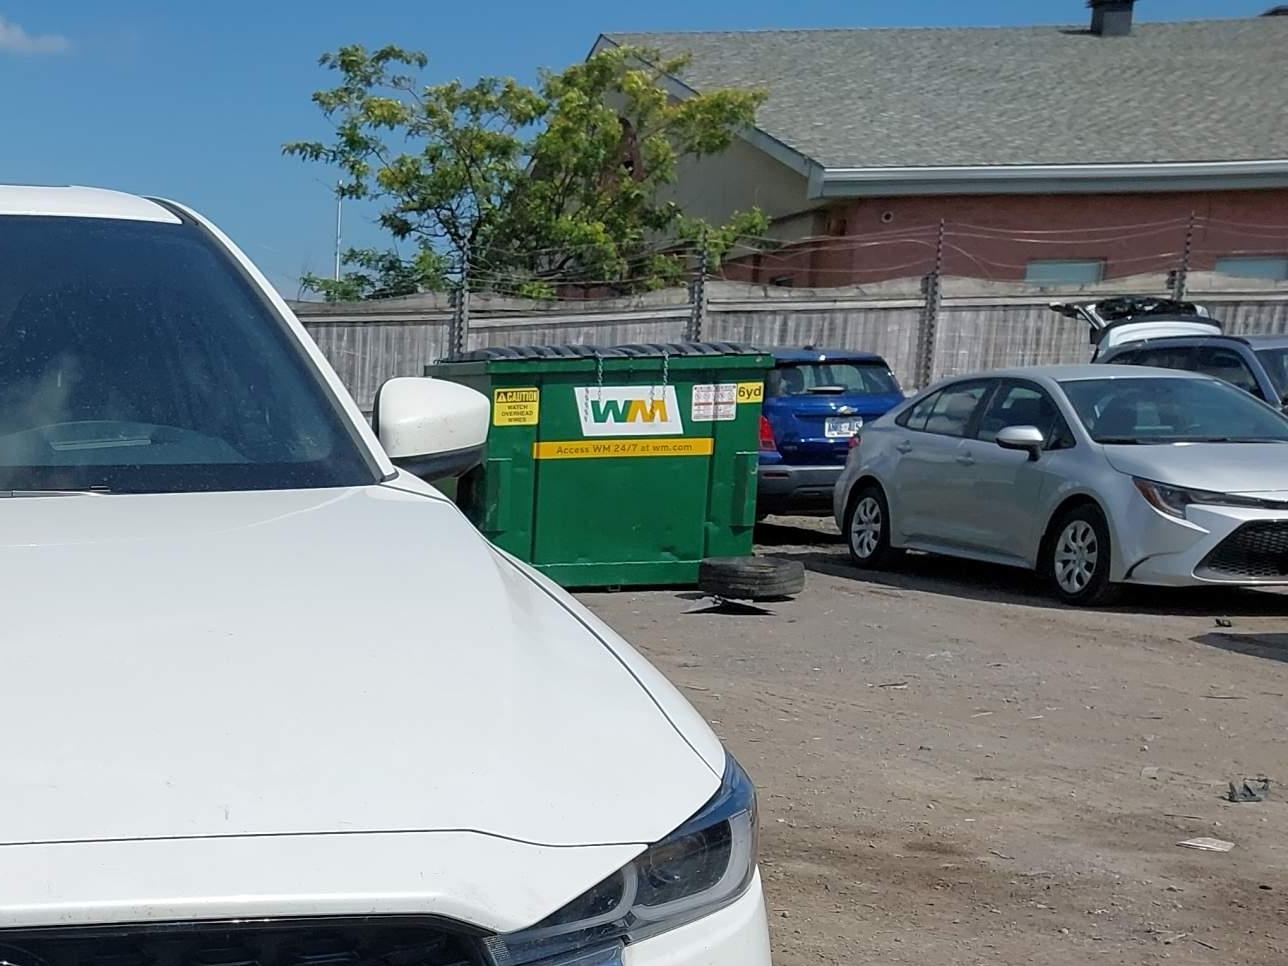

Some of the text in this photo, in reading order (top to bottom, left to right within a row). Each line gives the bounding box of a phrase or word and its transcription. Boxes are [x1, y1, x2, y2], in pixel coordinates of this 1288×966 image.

[738, 385, 762, 399] 6yd
[590, 399, 668, 423] WM
[556, 443, 693, 455] Access WM 24/7 at wm.com
